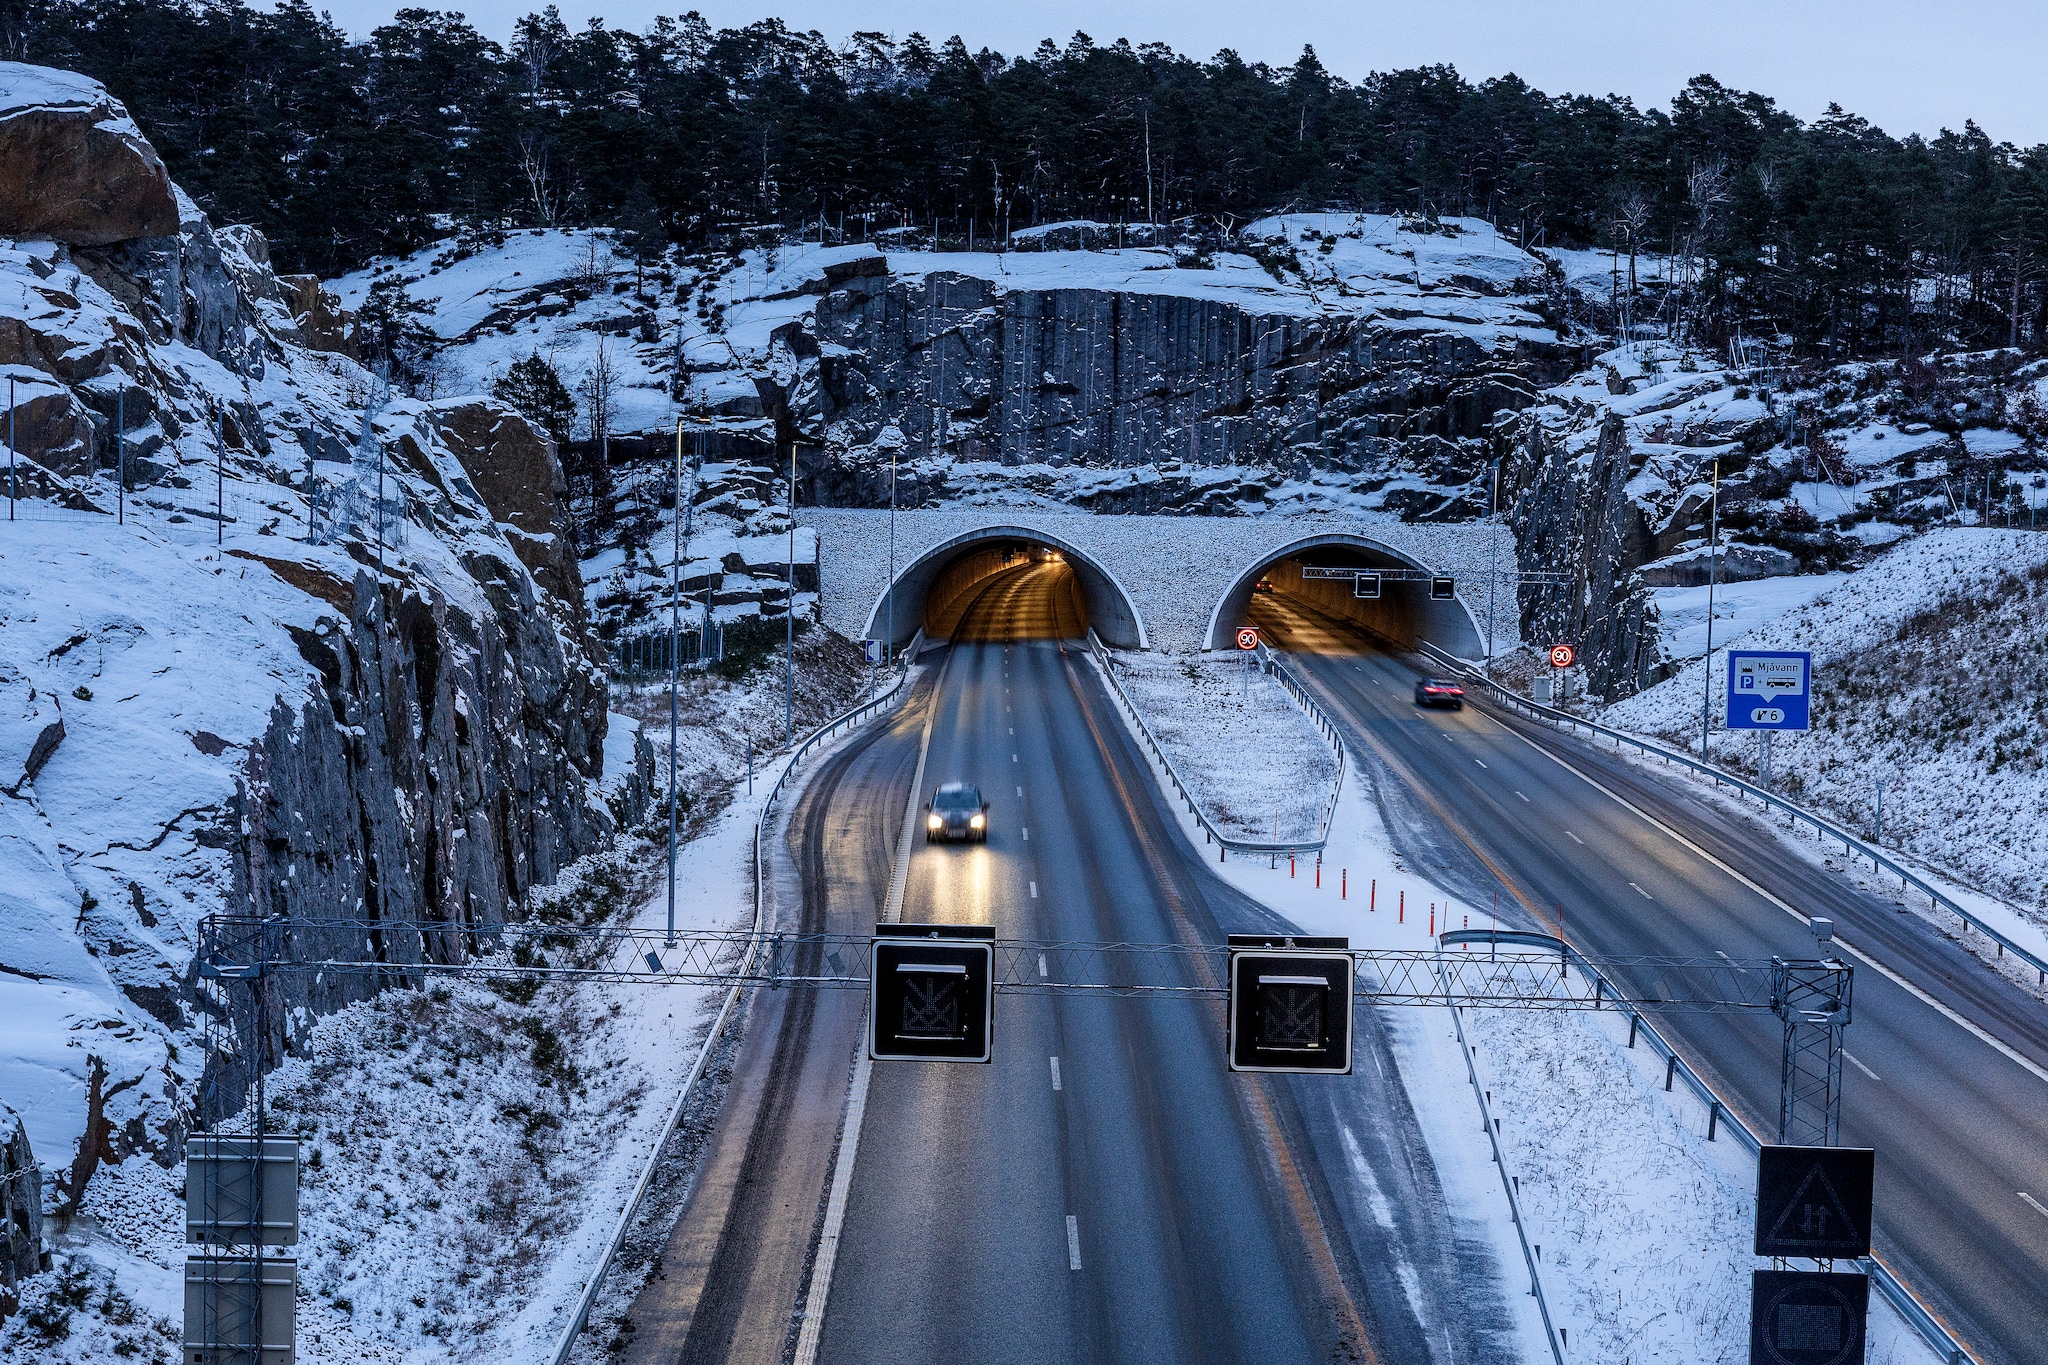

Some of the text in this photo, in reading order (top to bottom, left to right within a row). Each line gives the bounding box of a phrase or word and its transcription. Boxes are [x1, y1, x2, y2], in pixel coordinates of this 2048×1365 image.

[1240, 633, 1255, 645] 90
[1554, 650, 1569, 662] 90
[1757, 662, 1798, 673] Mjåvann
[1743, 676, 1752, 688] P
[1770, 710, 1778, 721] 6
